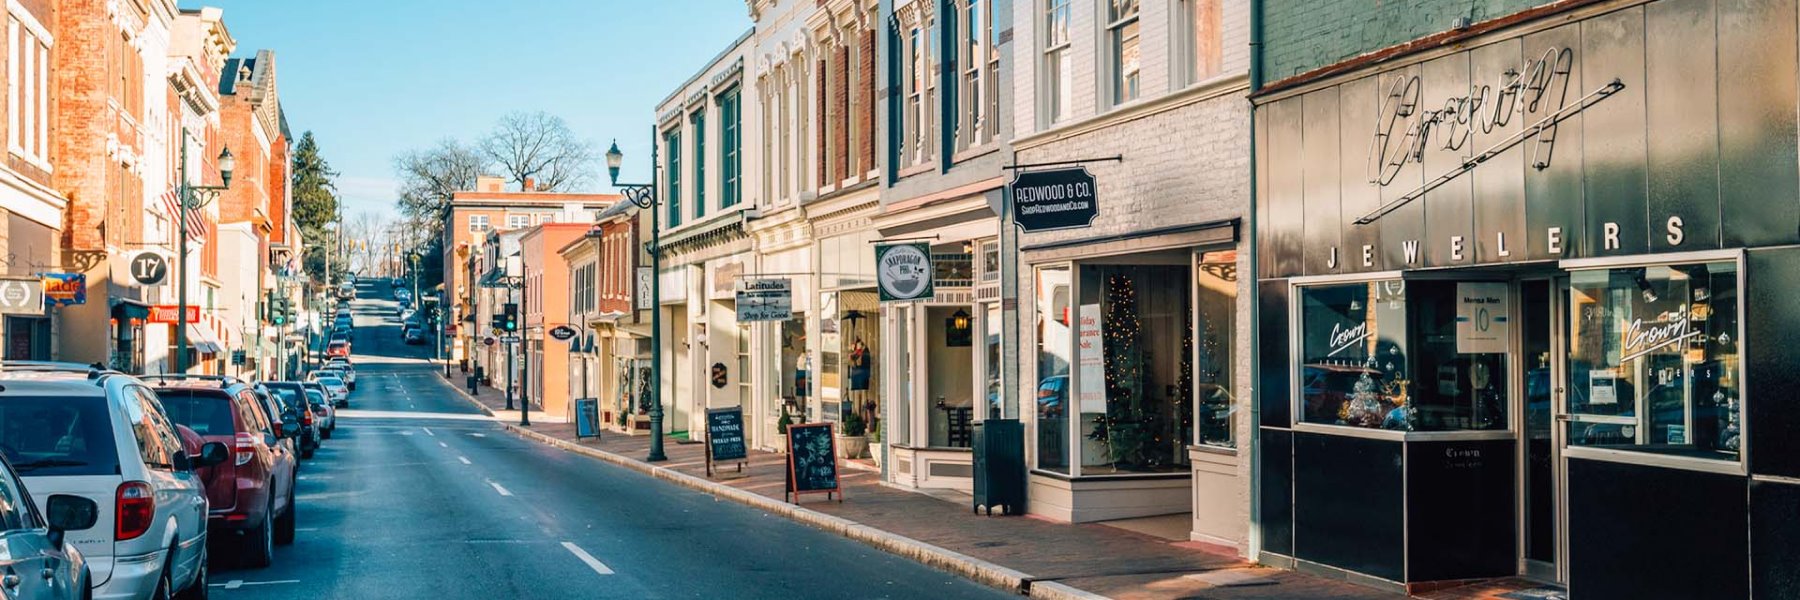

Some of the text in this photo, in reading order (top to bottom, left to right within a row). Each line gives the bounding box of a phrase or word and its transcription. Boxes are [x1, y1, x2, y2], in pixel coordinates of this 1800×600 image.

[1016, 182, 1092, 203] REDWOOD & CO.
[1327, 216, 1685, 269] JEWELERS
[137, 258, 160, 279] 17
[745, 281, 785, 290] Latitudes
[1474, 307, 1490, 332] 10
[1330, 321, 1367, 348] Crown
[1625, 318, 1687, 351] Crown
